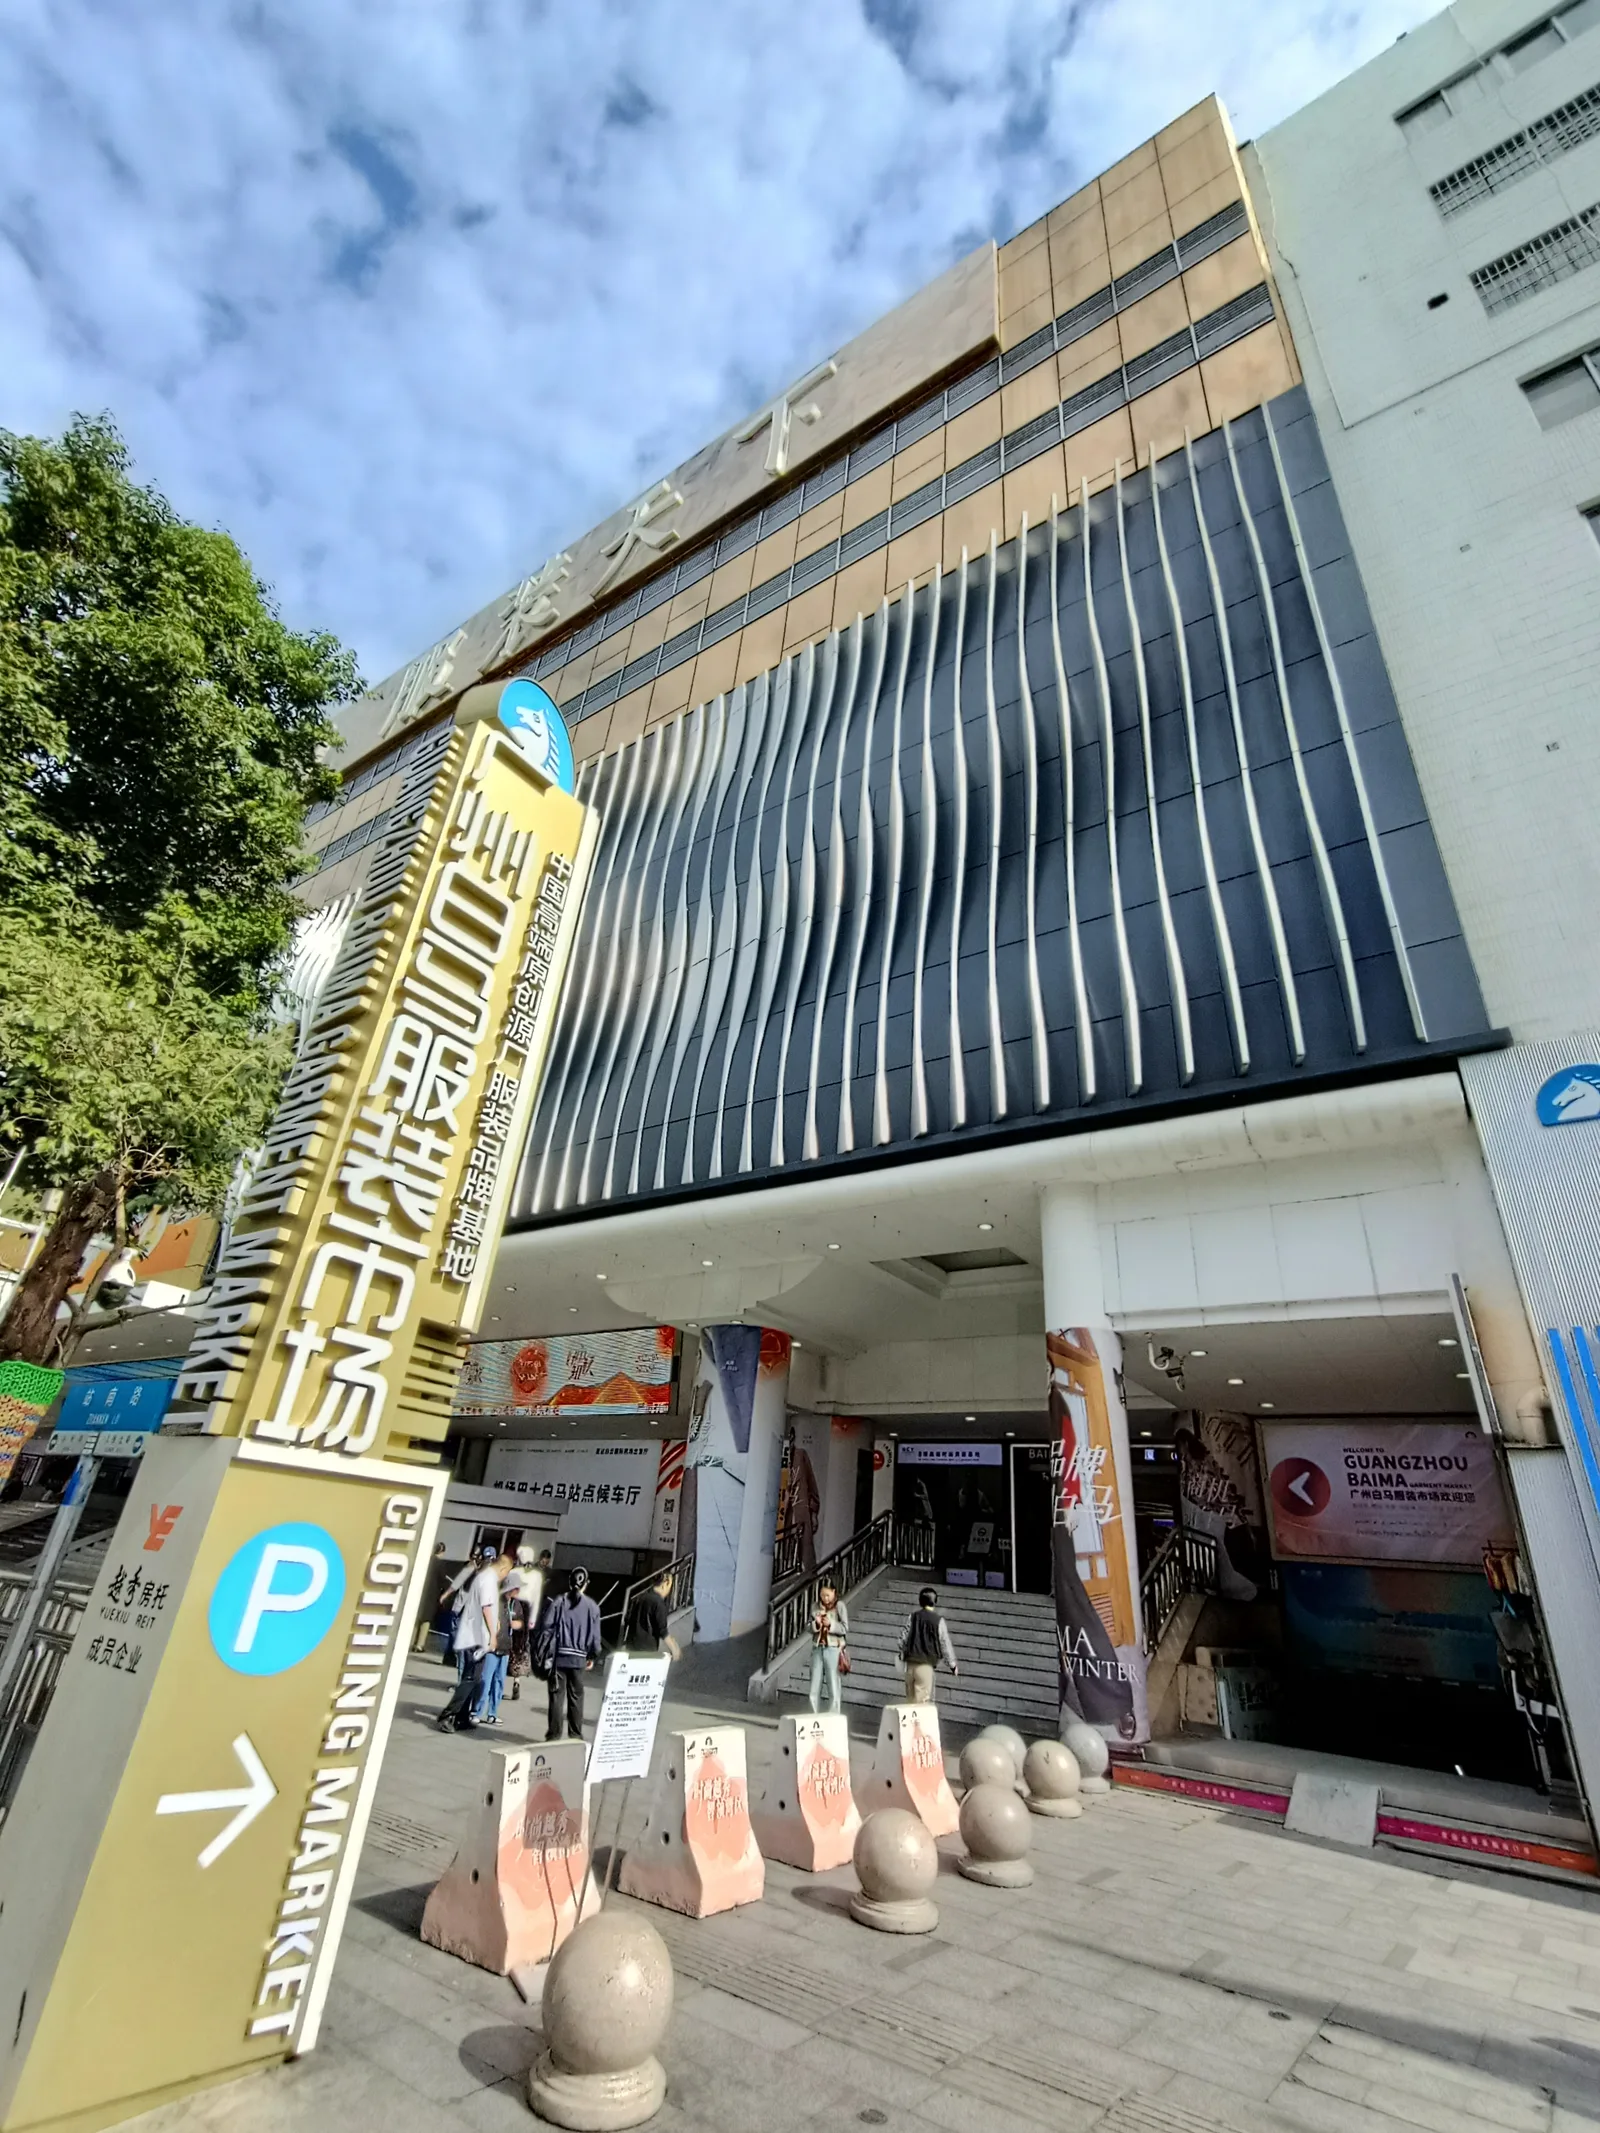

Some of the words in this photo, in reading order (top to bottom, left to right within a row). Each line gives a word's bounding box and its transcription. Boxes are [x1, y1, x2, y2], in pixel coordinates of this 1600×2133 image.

[361, 725, 457, 912] GUANGZHOU
[308, 901, 394, 1033] BAIMA
[256, 730, 561, 1456] 广州白马服装市场
[440, 852, 574, 1284] 中国高端原创源厂服装品牌基地
[240, 1024, 351, 1217] GARMENT
[162, 1227, 280, 1434] MARKET
[1050, 1439, 1107, 1481] 品牌
[1344, 1455, 1468, 1471] GUANGZHOU
[1347, 1472, 1407, 1488] BAIMA
[1350, 1490, 1476, 1503] 广州白马服装市场欢迎您
[1052, 1485, 1123, 1530] 白马
[100, 1606, 131, 1624] YUEXIU
[135, 1614, 156, 1629] REIT
[107, 1565, 170, 1611] 越秀房托
[234, 1543, 329, 1654] P
[325, 1493, 424, 1755] CLOTHING
[86, 1635, 143, 1674] 成员企业
[1062, 1656, 1141, 1685] WINTER
[249, 1766, 360, 2043] MARKET
